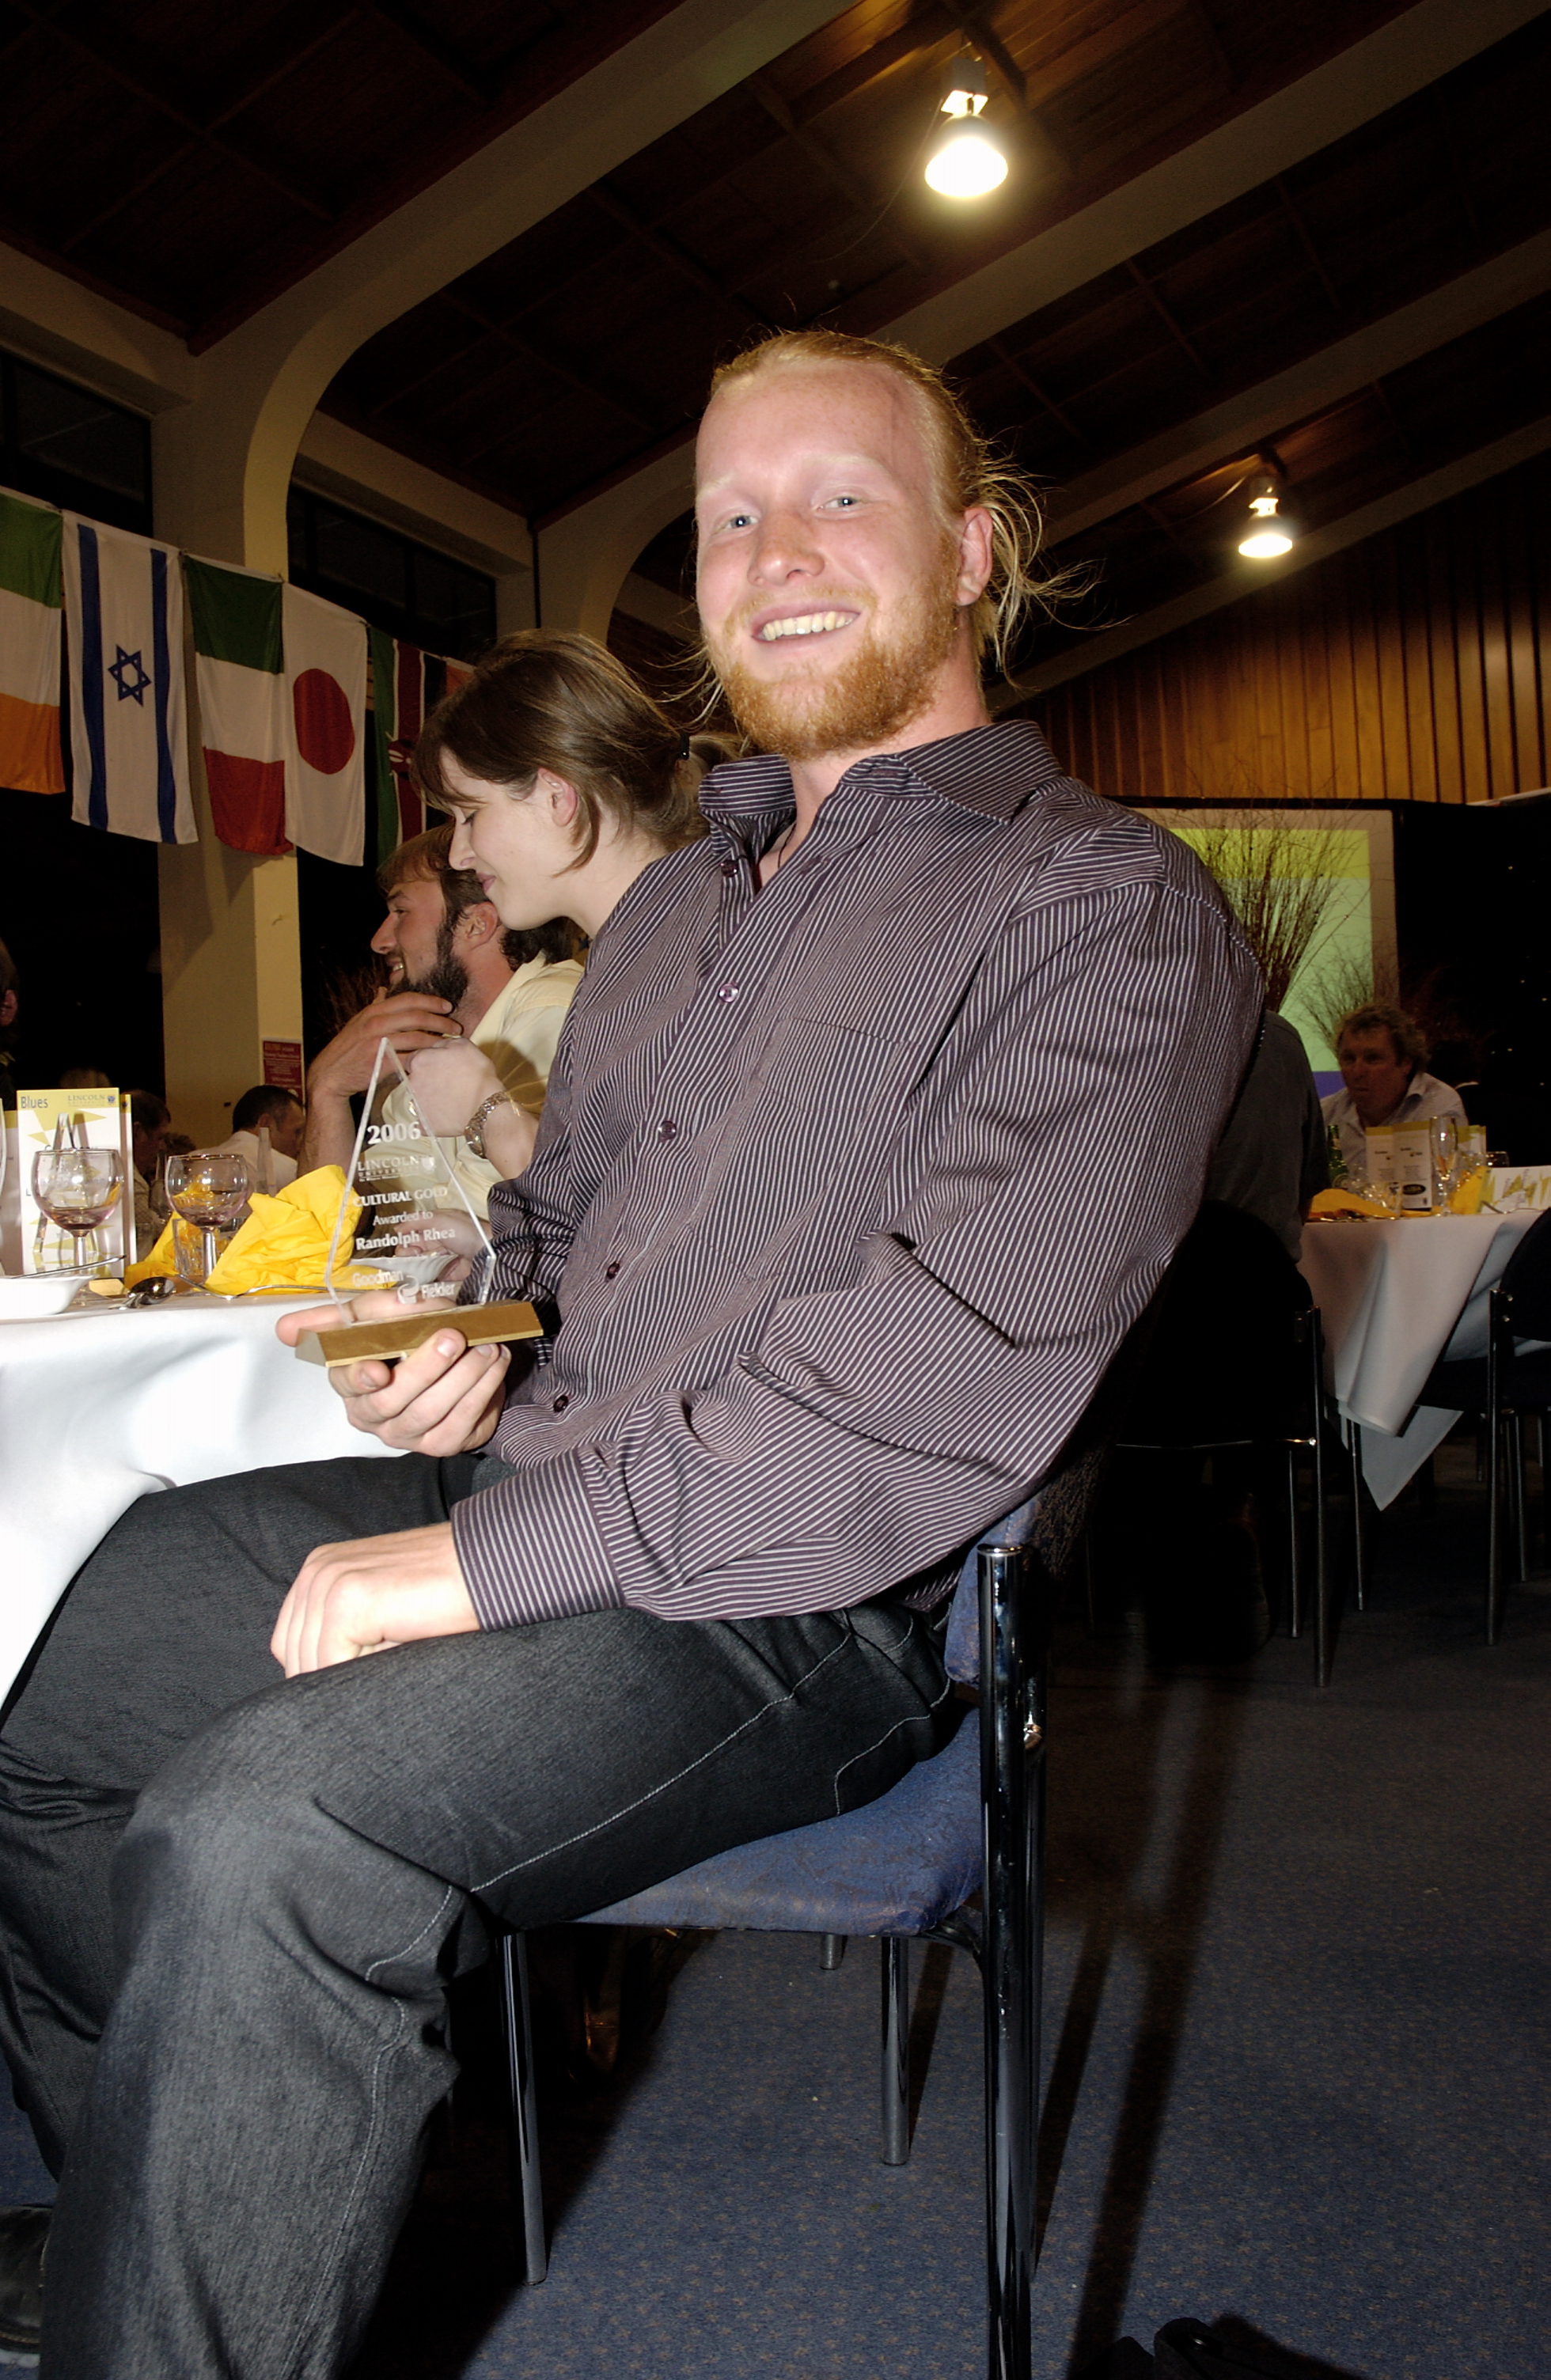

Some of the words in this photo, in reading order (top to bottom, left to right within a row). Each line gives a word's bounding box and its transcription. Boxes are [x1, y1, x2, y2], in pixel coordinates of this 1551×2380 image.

[21, 1096, 49, 1109] Blues
[366, 1121, 421, 1145] 2006
[358, 1156, 419, 1171] LINCOLN
[353, 1191, 412, 1207] CULTURAL
[414, 1186, 448, 1200] GOLD
[373, 1211, 420, 1226] Awarded
[355, 1230, 420, 1250] Randolph
[423, 1227, 456, 1241] Rhea
[352, 1269, 404, 1287] Goodman
[421, 1282, 456, 1299] Fielder
